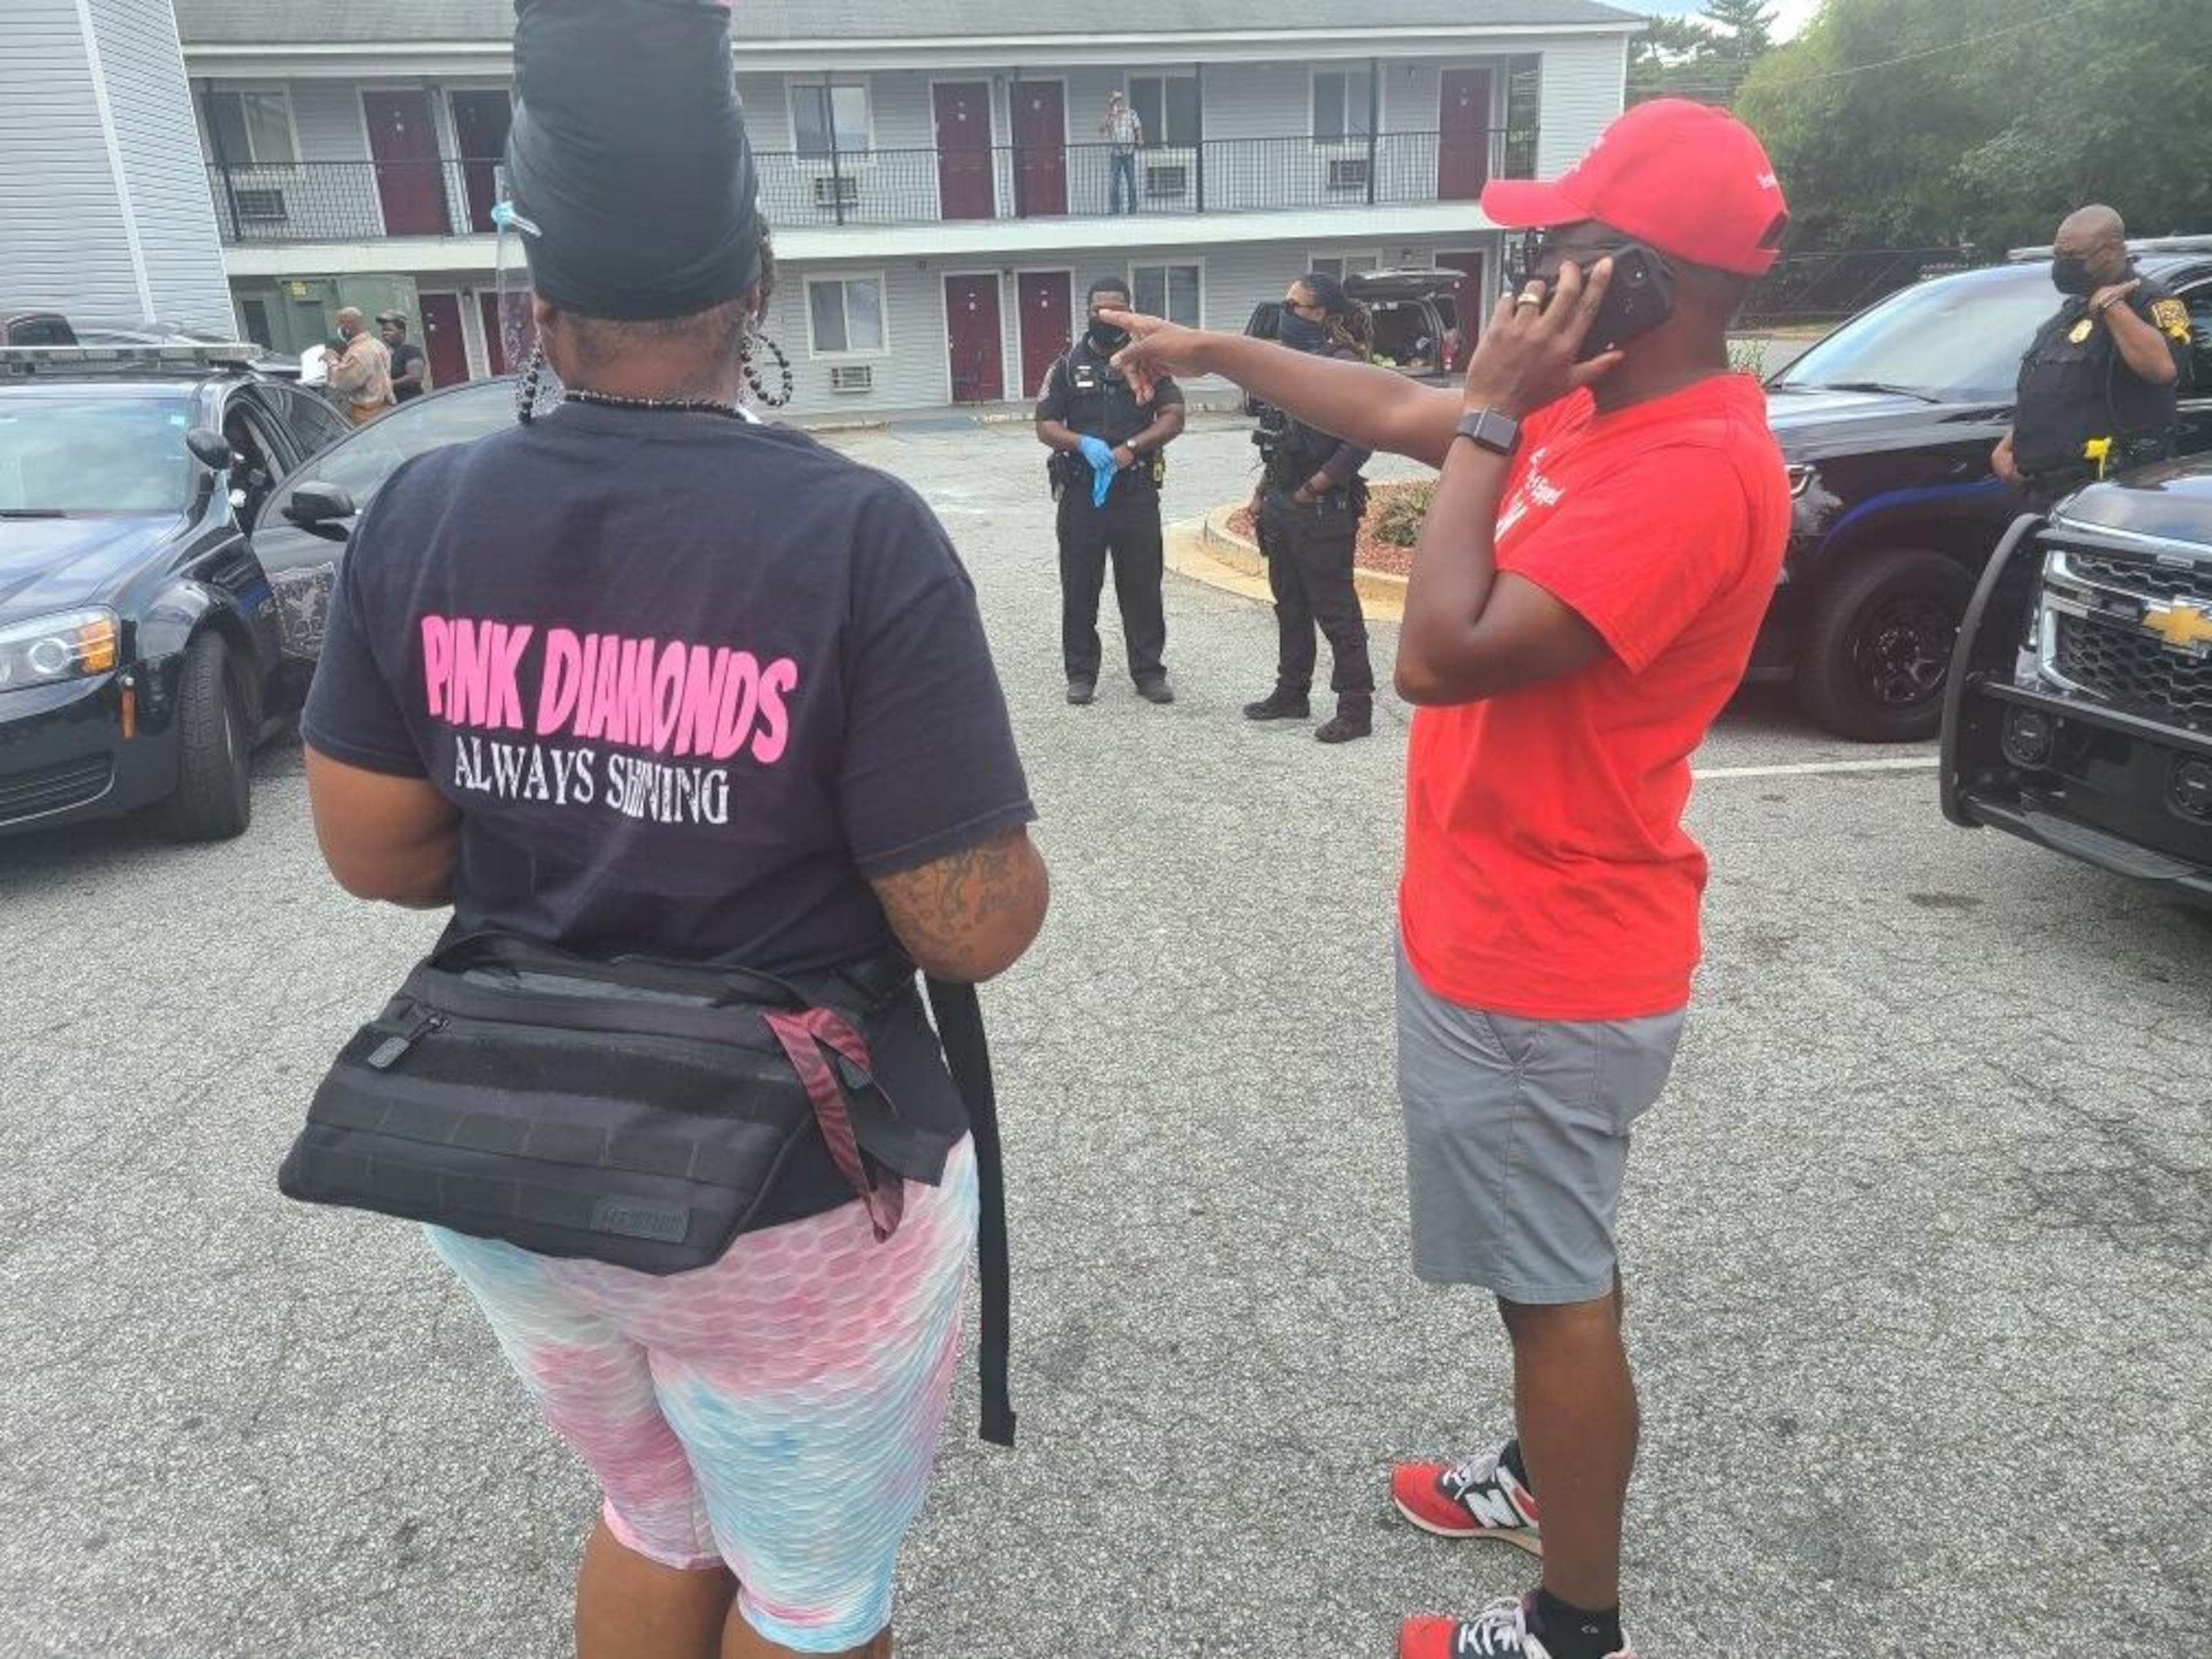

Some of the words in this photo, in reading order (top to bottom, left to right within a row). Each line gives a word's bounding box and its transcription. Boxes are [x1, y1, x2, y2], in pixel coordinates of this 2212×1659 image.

[421, 615, 533, 729] PINK
[536, 628, 798, 764] DIAMONDS
[455, 736, 595, 805] ALWAYS
